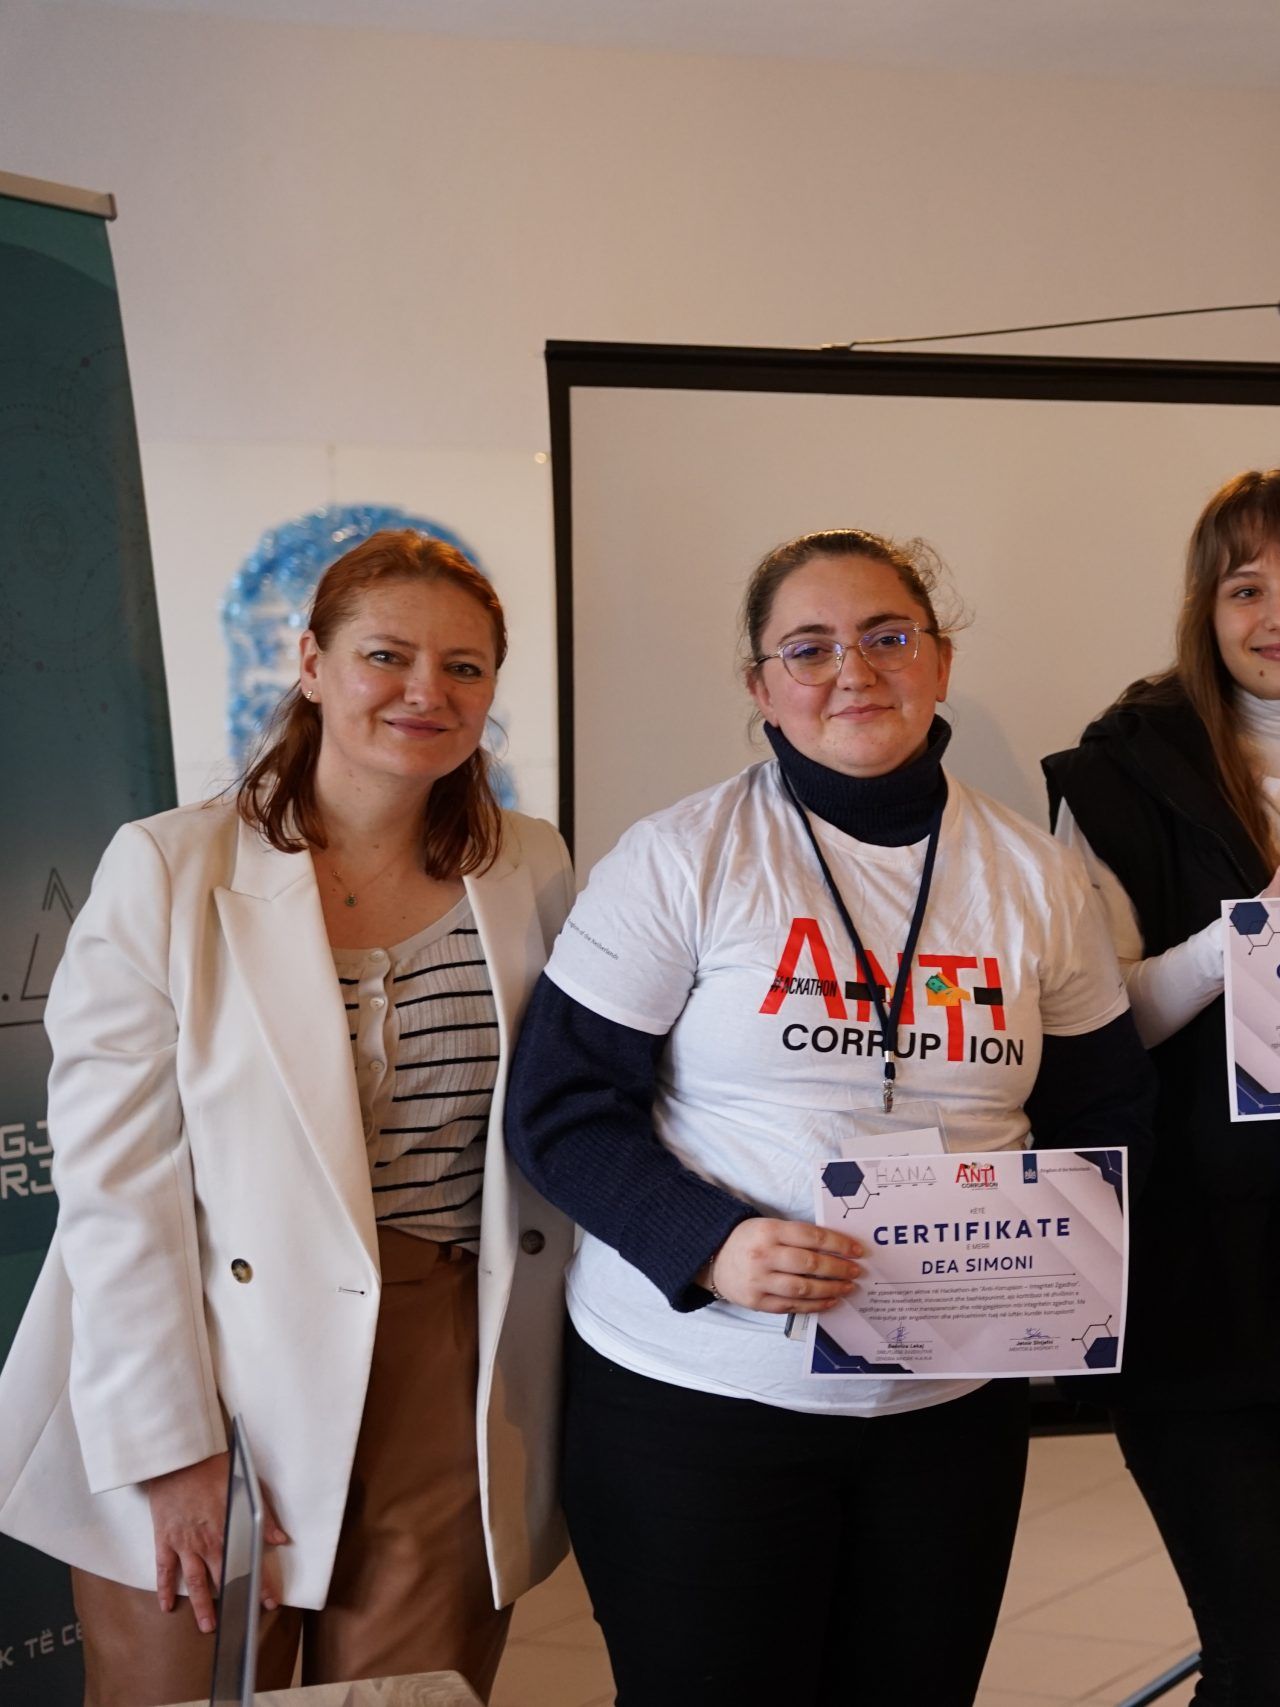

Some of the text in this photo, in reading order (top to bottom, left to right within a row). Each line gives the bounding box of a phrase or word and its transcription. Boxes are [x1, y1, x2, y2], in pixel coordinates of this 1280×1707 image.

[759, 918, 1006, 1062] ANTI
[955, 1163, 996, 1187] ANTI
[873, 1217, 1070, 1246] CERTIFIKATE
[922, 1255, 1034, 1275] DEA SIMONI
[24, 1628, 54, 1659] TË
